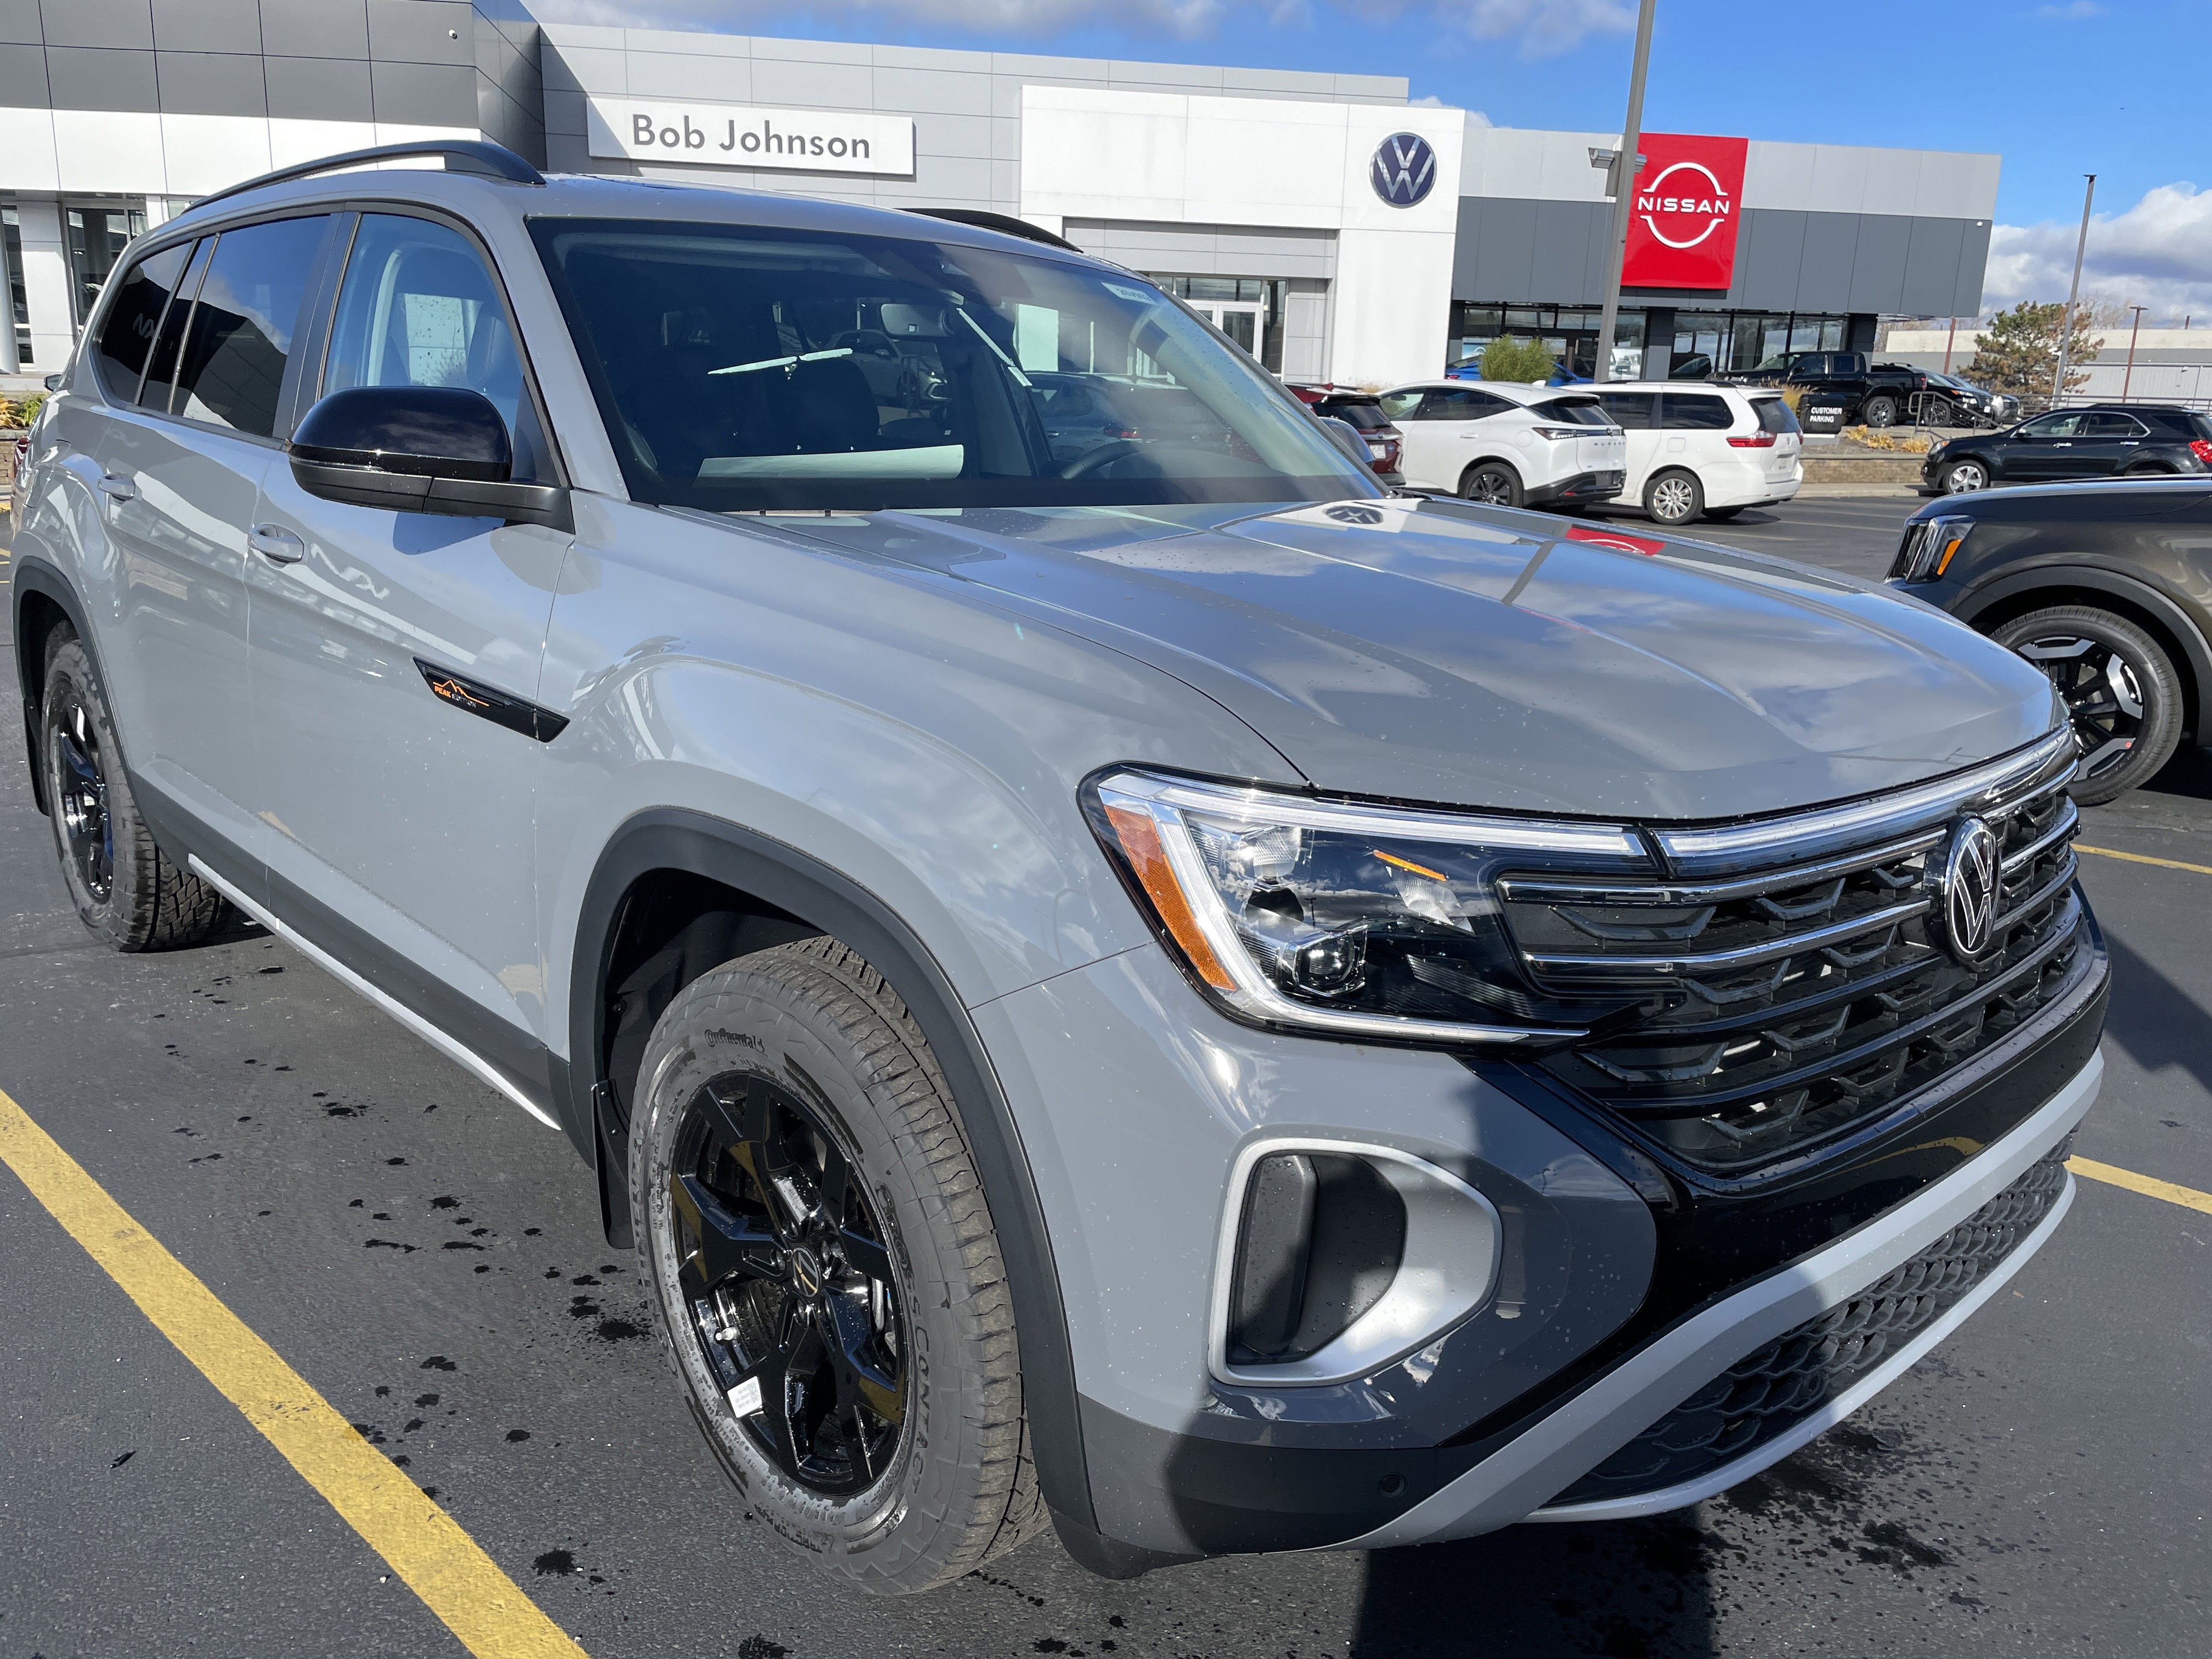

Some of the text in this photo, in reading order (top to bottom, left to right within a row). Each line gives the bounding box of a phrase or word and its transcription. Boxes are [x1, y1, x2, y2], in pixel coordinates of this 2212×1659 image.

[632, 114, 871, 159] Bob Johnson
[1373, 134, 1435, 204] VW
[1638, 196, 1730, 215] NISSAN
[1811, 407, 1842, 415] CUSTOMER
[435, 686, 451, 698] PEAK
